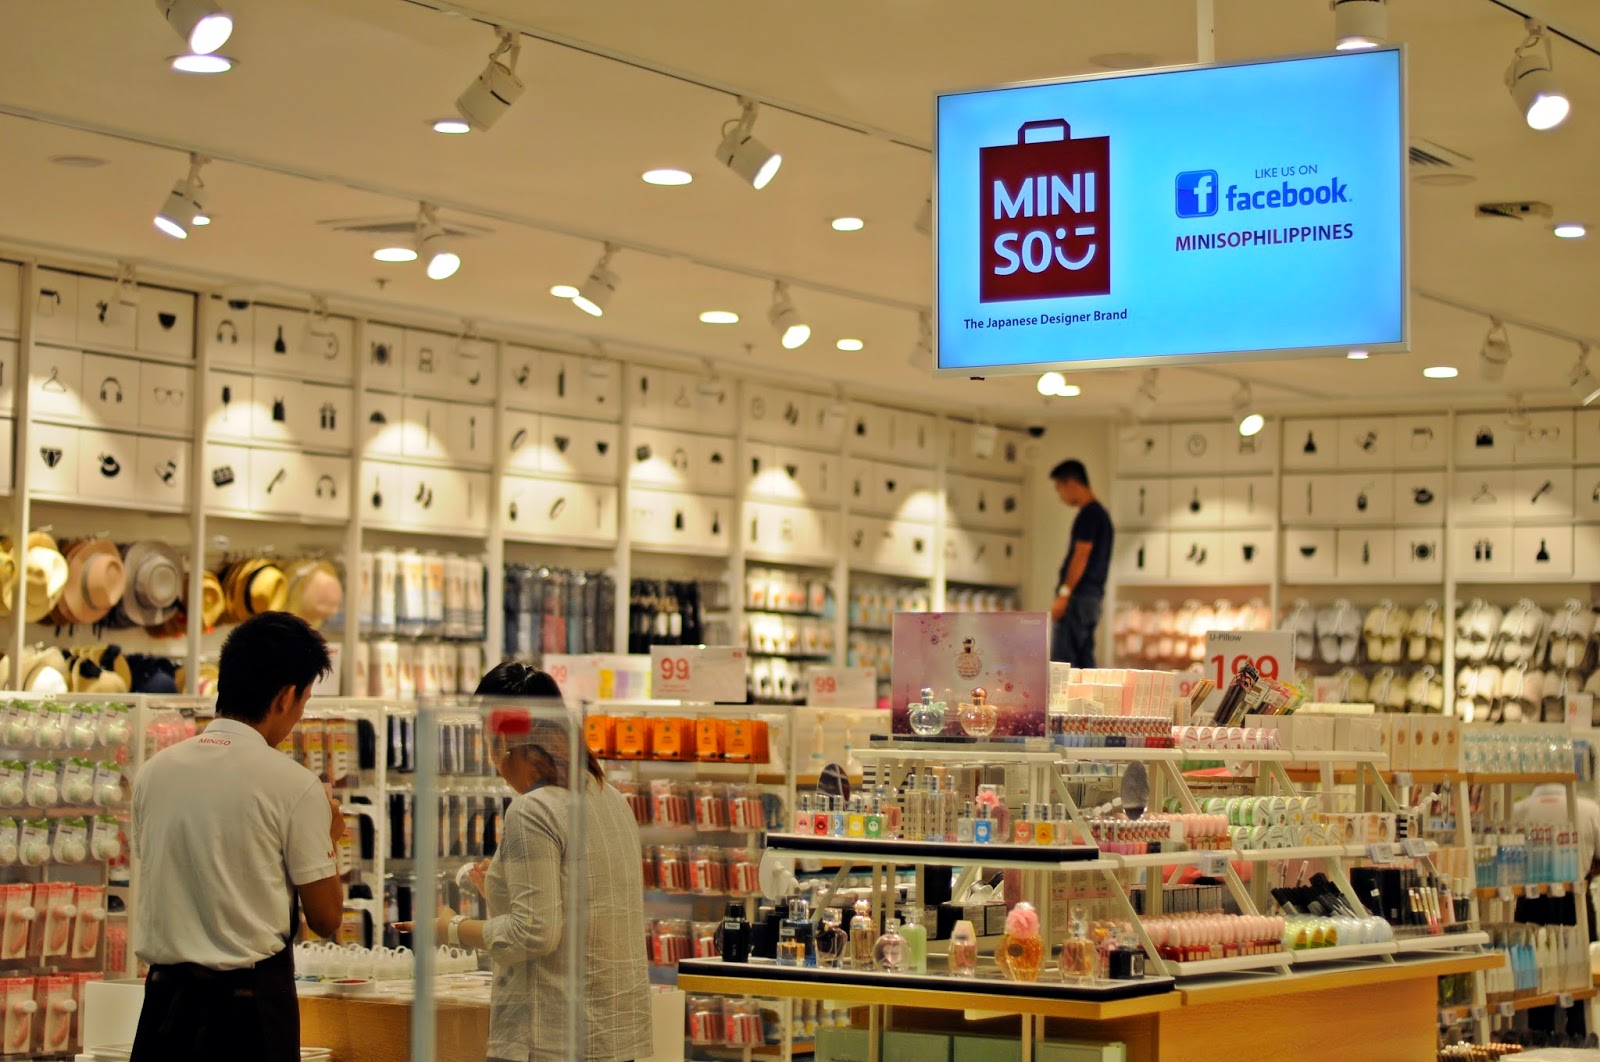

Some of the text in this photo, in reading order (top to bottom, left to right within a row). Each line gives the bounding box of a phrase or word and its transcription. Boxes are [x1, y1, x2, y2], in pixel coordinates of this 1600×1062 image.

[1255, 164, 1318, 179] LIKE US ON
[994, 172, 1095, 220] MINI
[1176, 223, 1354, 251] MINISOPHILIPPINES
[964, 309, 1128, 330] The Japanese Designer Brand
[1209, 633, 1242, 642] U-Pillow
[199, 738, 231, 746] MINISO
